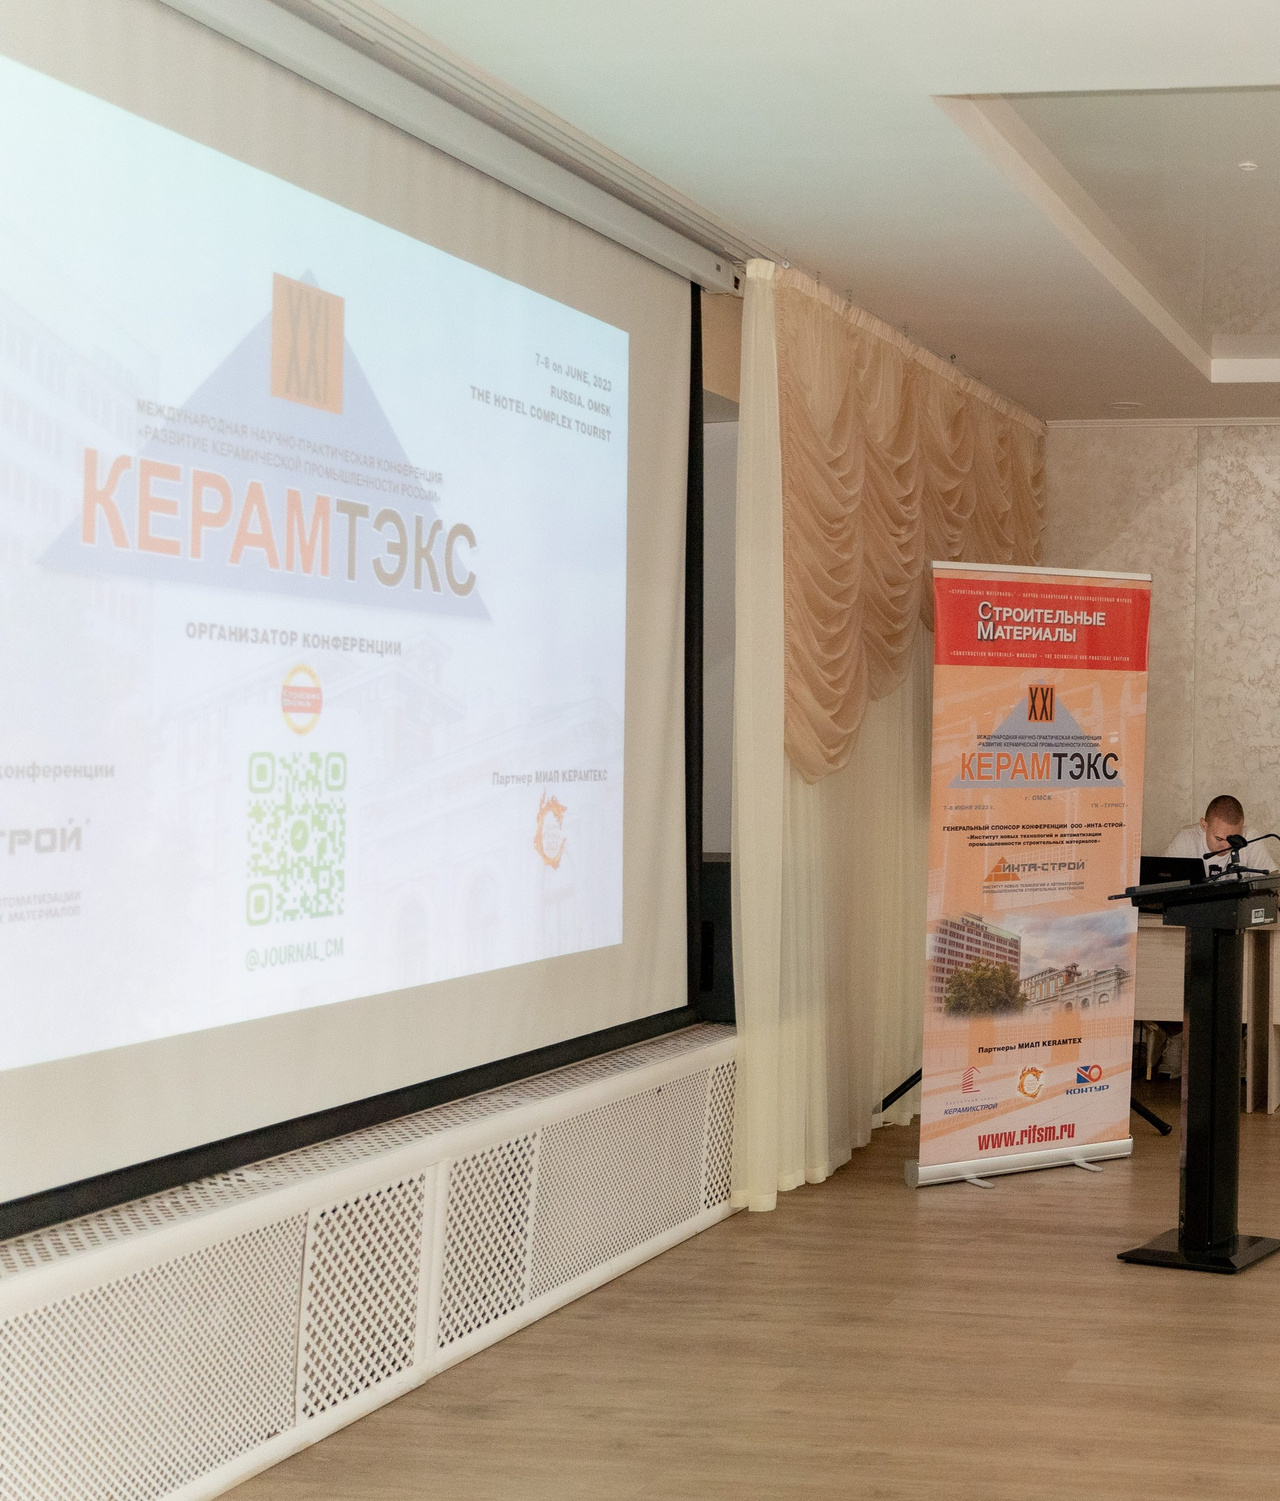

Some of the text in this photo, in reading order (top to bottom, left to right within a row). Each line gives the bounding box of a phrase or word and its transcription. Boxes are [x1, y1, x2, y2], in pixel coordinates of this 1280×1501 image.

[284, 283, 329, 405] XXI
[552, 362, 563, 375] on
[565, 364, 591, 388] JUNE,
[593, 375, 612, 393] 2023
[470, 385, 612, 443] THE HOTEL COMPLEX TOURIST
[587, 399, 612, 418] OMSK
[136, 399, 443, 485] МЕЖДУНАРОДНАЯ НАУЧНО-ПРАКТИЧЕСКАЯ КОНФЕРЕНЦИЯ
[137, 424, 208, 453] «РАЗВИТИЕ
[211, 438, 301, 472] КЕРАМИЧЕСКОЙ
[303, 459, 400, 494] ПРОМЫШЛЕННОСТИ
[81, 447, 478, 597] КЕРАМТЭКС
[186, 621, 402, 657] ОРГАНИЗАТОР КОНФЕРЕНЦИИ
[1029, 687, 1053, 721] XXI
[492, 768, 609, 787] Партнер МИАП КЕРАМТЕКС
[960, 751, 1119, 782] КЕРАМТЭКС
[1031, 794, 1053, 802] ОМСК
[943, 824, 989, 832] ГЕНЕРАЛЬНЫЙ
[1021, 823, 1067, 831] КОНФЕРЕНЦИИ
[1020, 832, 1053, 840] технологий
[1003, 858, 1085, 873] ИНТА-СТРОЙ
[8, 905, 81, 923] МАТЕРИАЛОВ
[245, 936, 344, 972] @JOURNAL_CM
[978, 1045, 1016, 1054] Партнеры
[1018, 1041, 1040, 1050] МИАП
[1066, 1084, 1110, 1096] КОНТУР
[943, 1102, 998, 1116] КЕРАМИКСТРОЙ
[978, 1122, 1075, 1151] www.rifsm.ru
